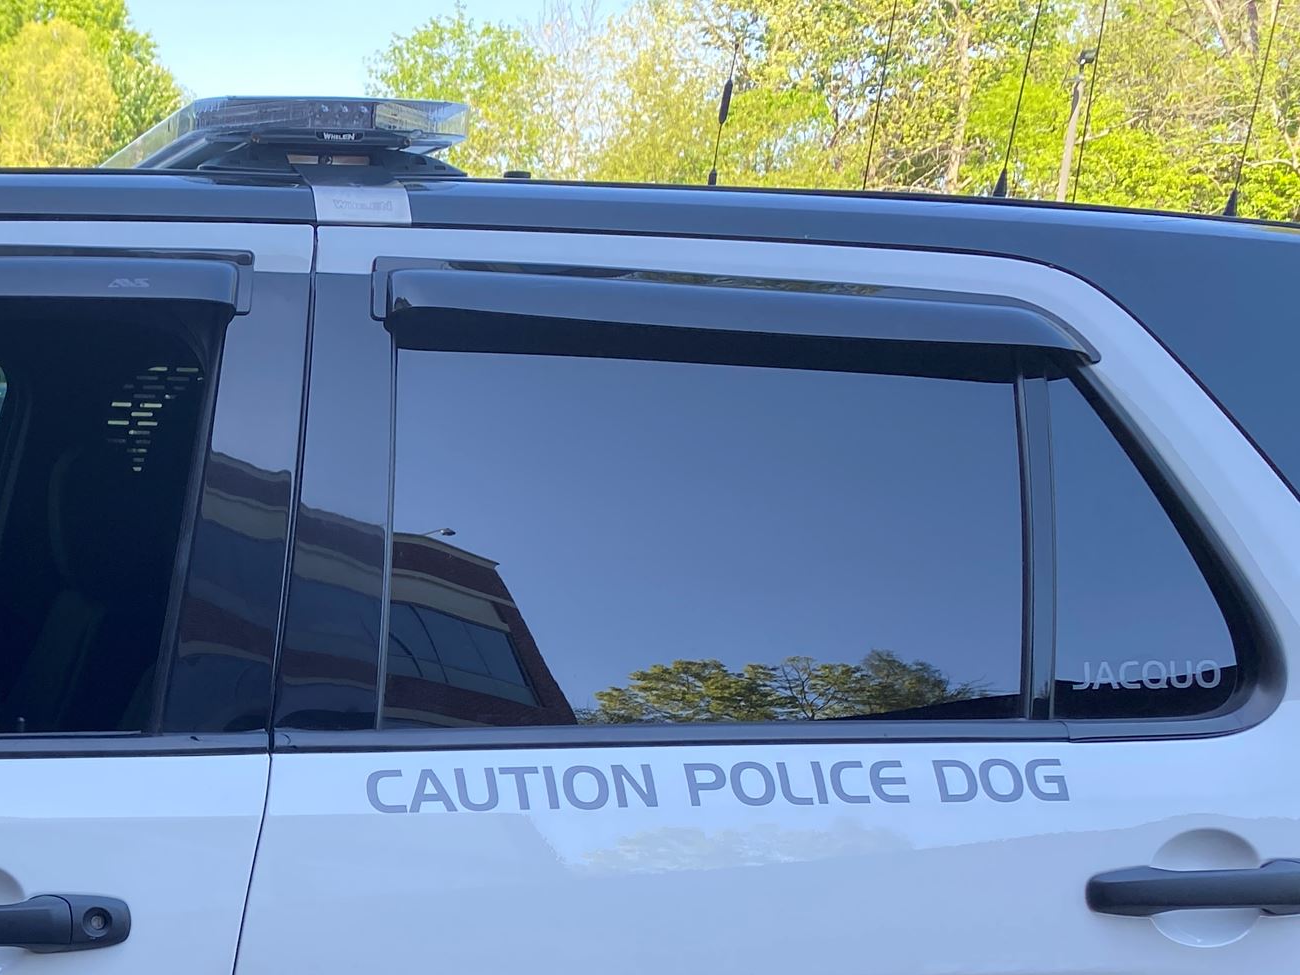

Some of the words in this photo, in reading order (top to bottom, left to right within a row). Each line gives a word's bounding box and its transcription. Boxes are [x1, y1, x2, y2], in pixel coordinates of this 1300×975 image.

[323, 132, 355, 140] WHELEN
[1071, 659, 1221, 690] JACQUO
[366, 764, 658, 813] CAUTION
[684, 760, 910, 806] POLICE
[932, 758, 1070, 803] DOG
